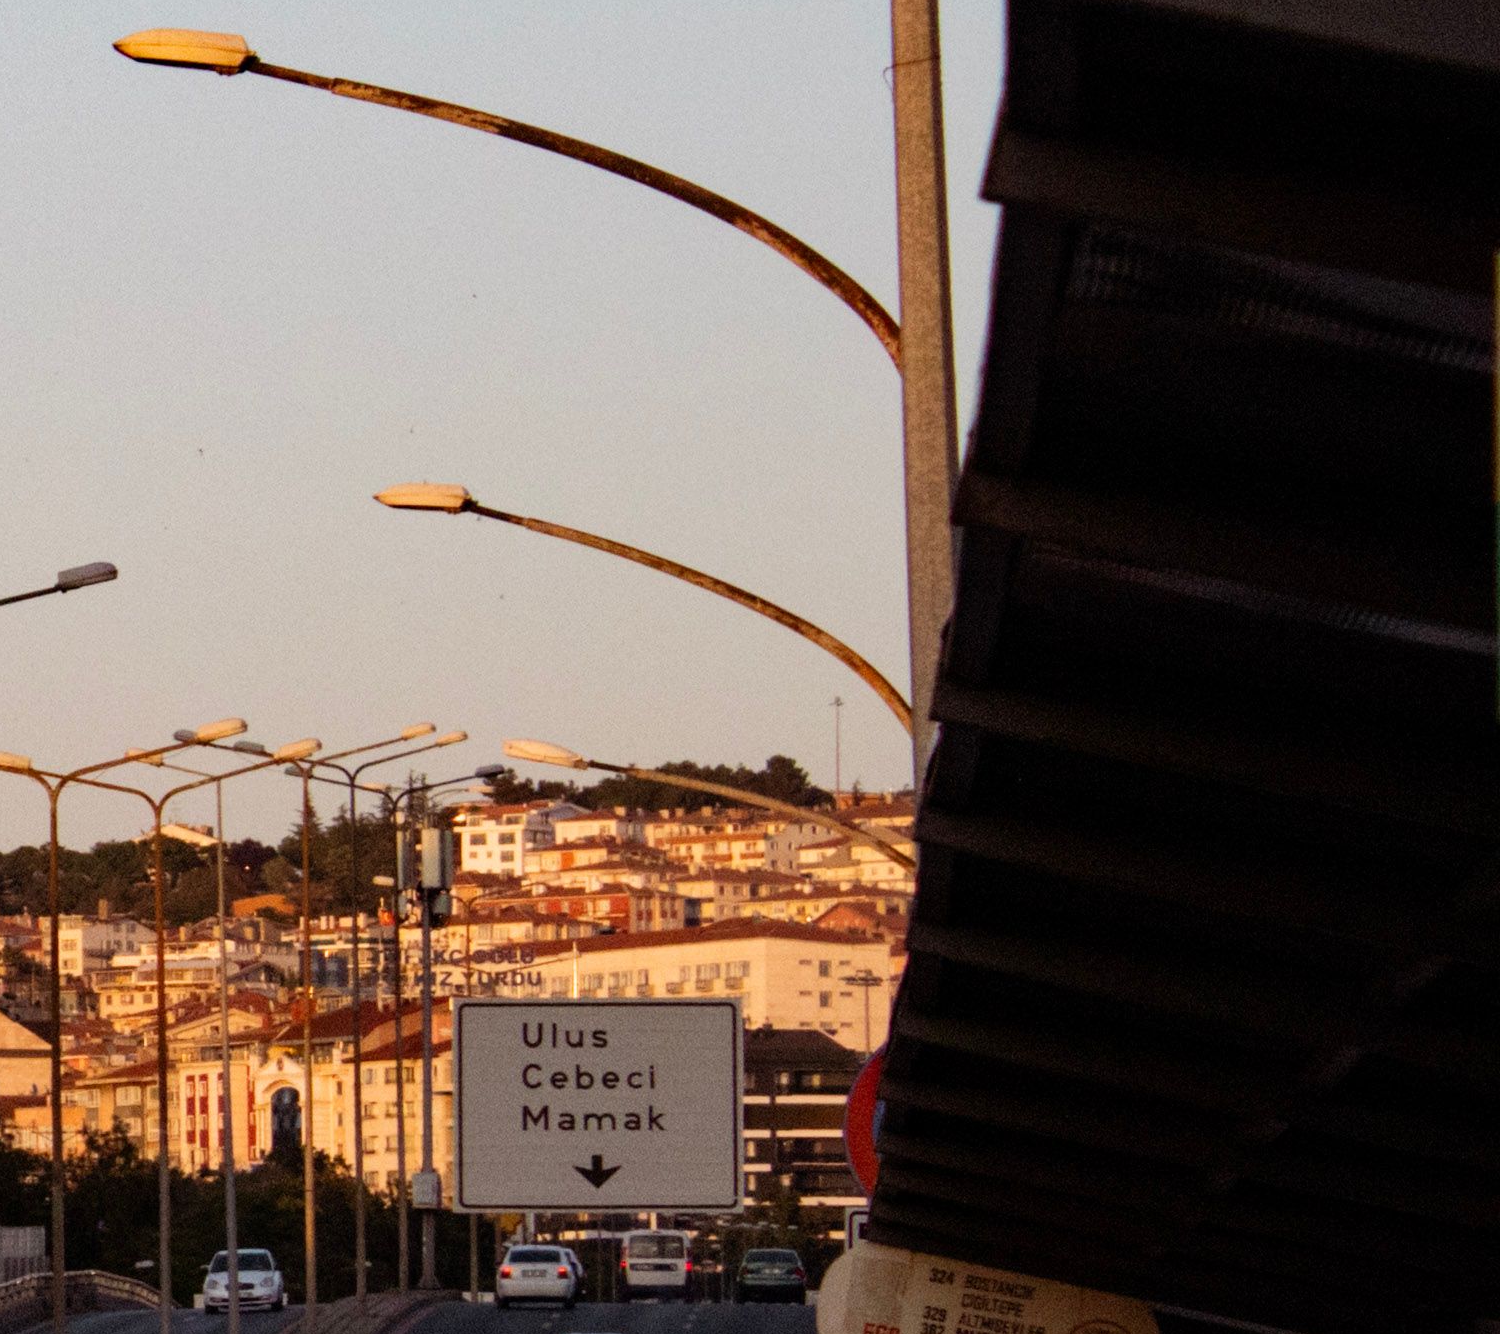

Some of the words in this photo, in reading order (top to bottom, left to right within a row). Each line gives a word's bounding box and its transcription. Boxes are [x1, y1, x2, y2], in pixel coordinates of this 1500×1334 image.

[521, 1022, 609, 1049] Ulus
[521, 1063, 657, 1091] Cebeci
[521, 1104, 667, 1132] Mamak
[929, 1267, 955, 1286] 324
